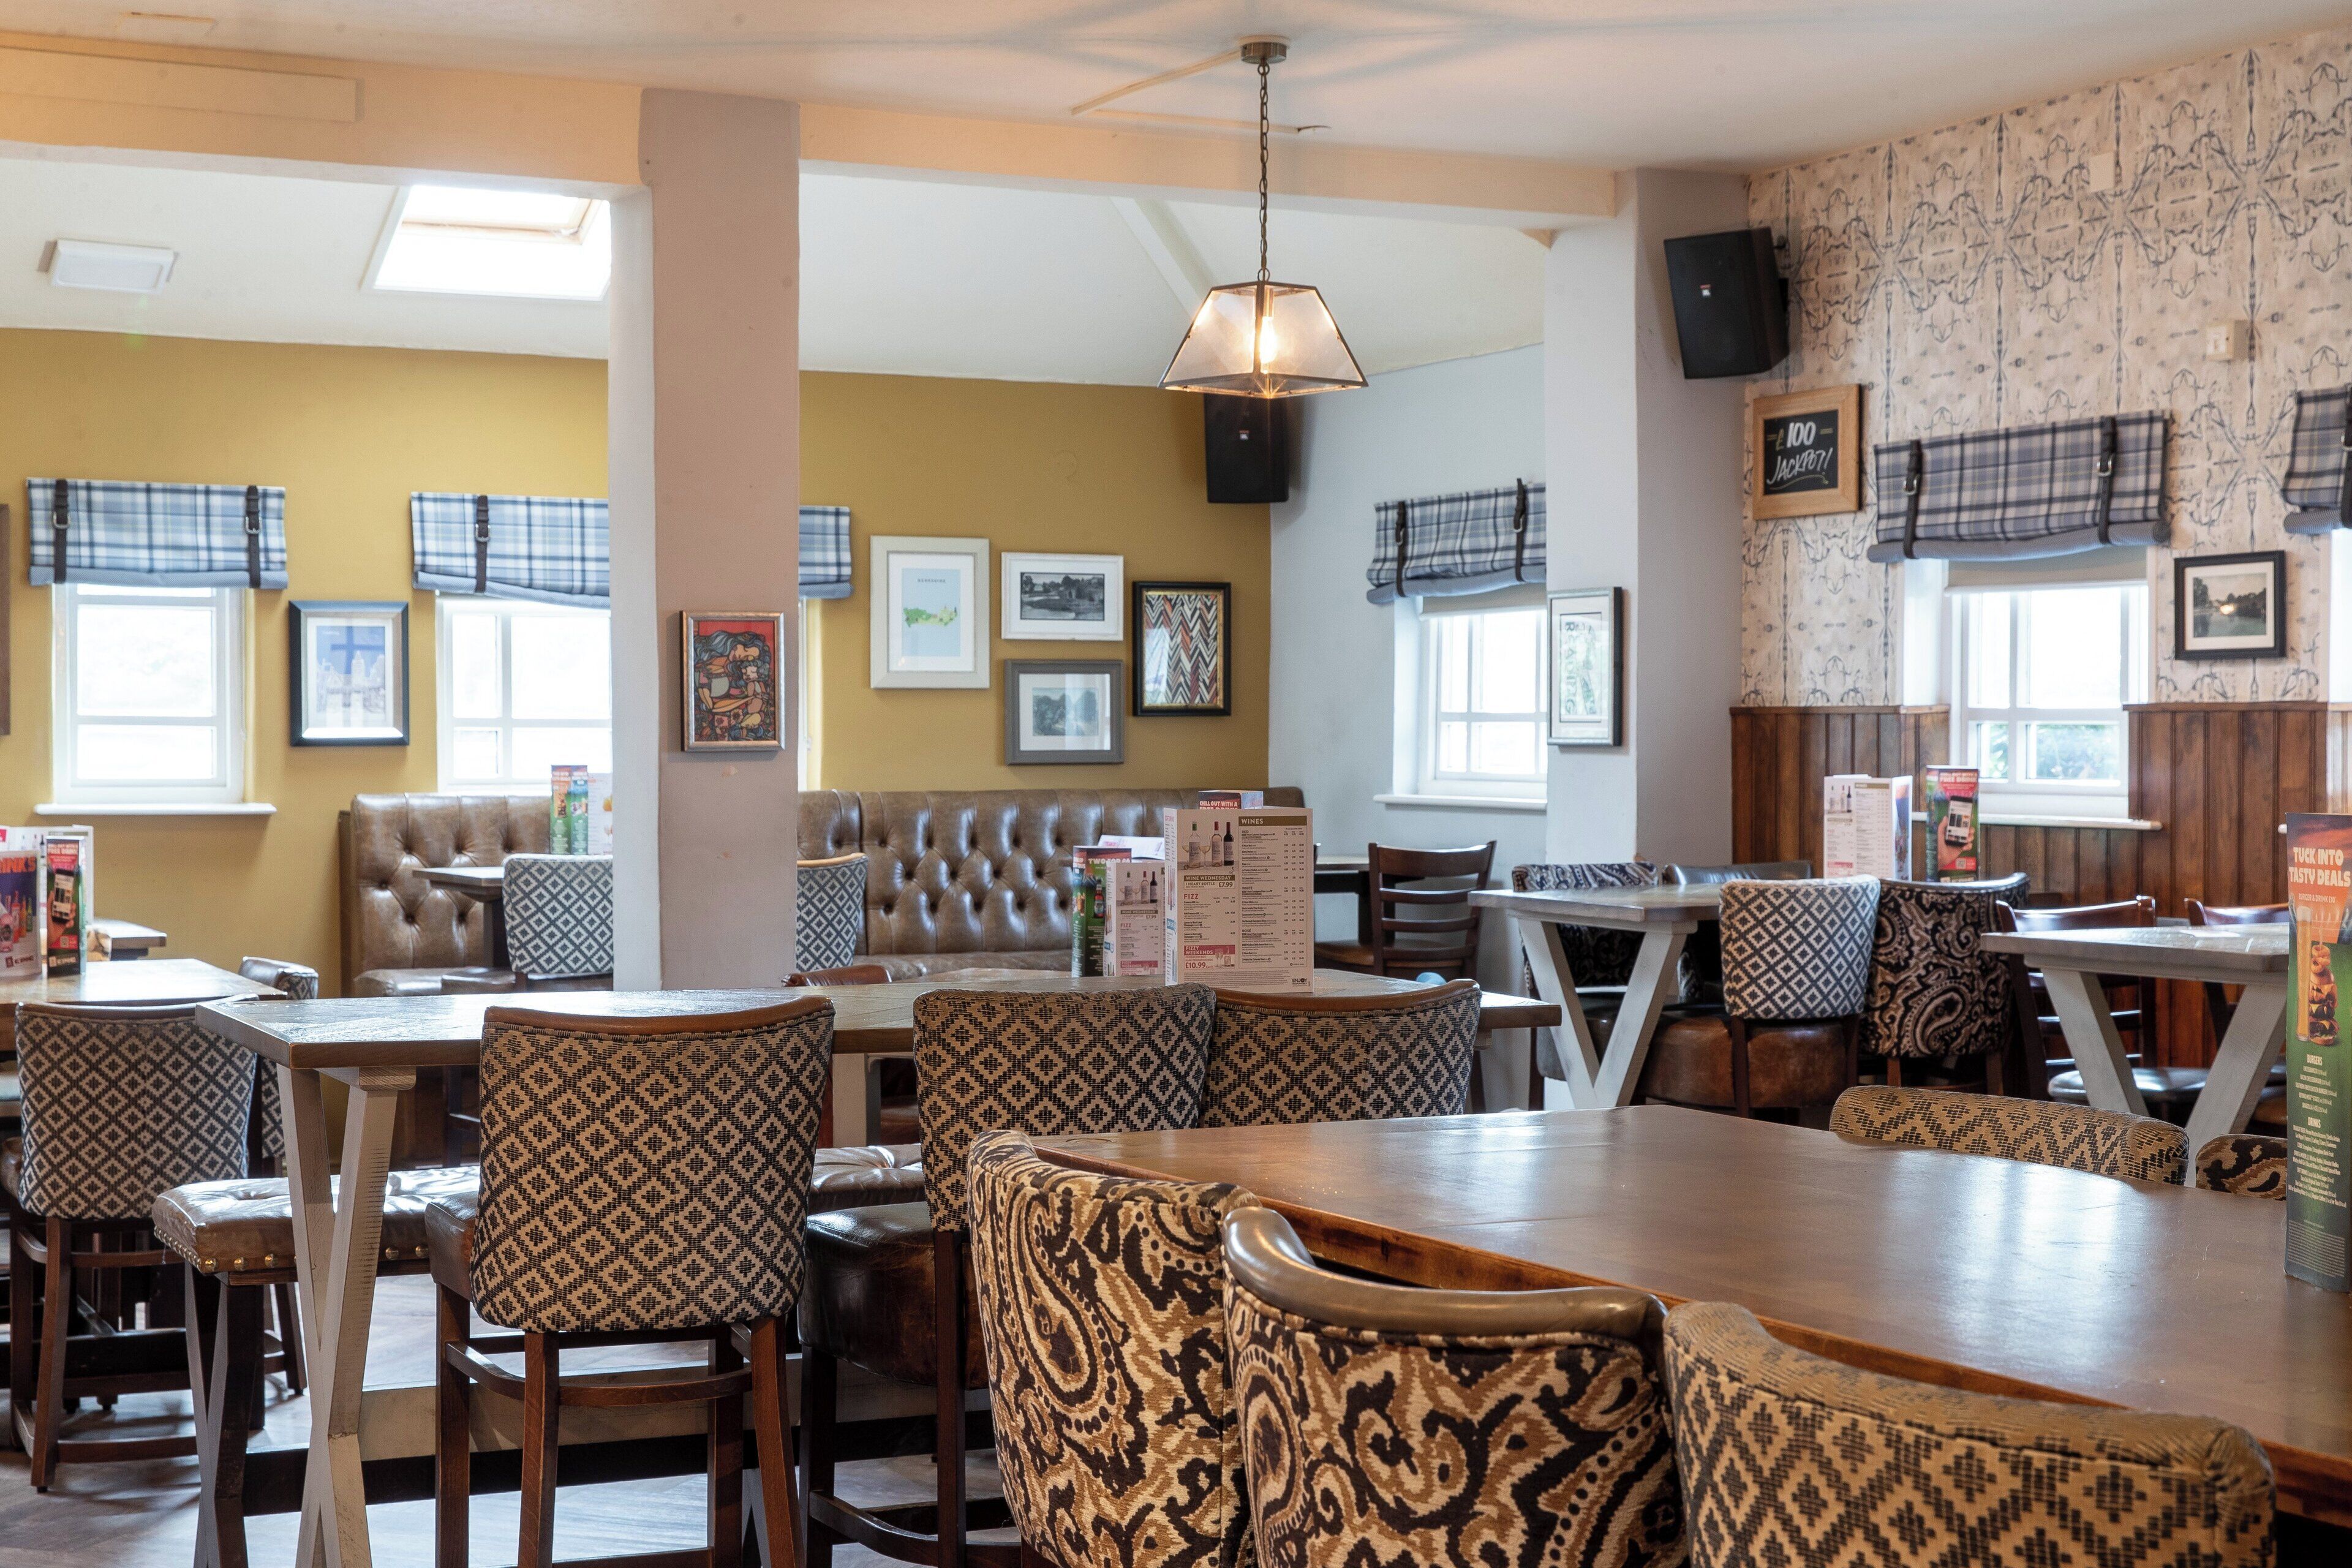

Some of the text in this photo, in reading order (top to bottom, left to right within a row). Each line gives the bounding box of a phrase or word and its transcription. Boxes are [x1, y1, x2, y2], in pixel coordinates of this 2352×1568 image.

[1766, 447, 1833, 484] JACKPOT!
[2293, 846, 2344, 866] TUCK INTO
[2288, 866, 2351, 888] TASTY DEALS
[2307, 1117, 2321, 1129] DRINKS
